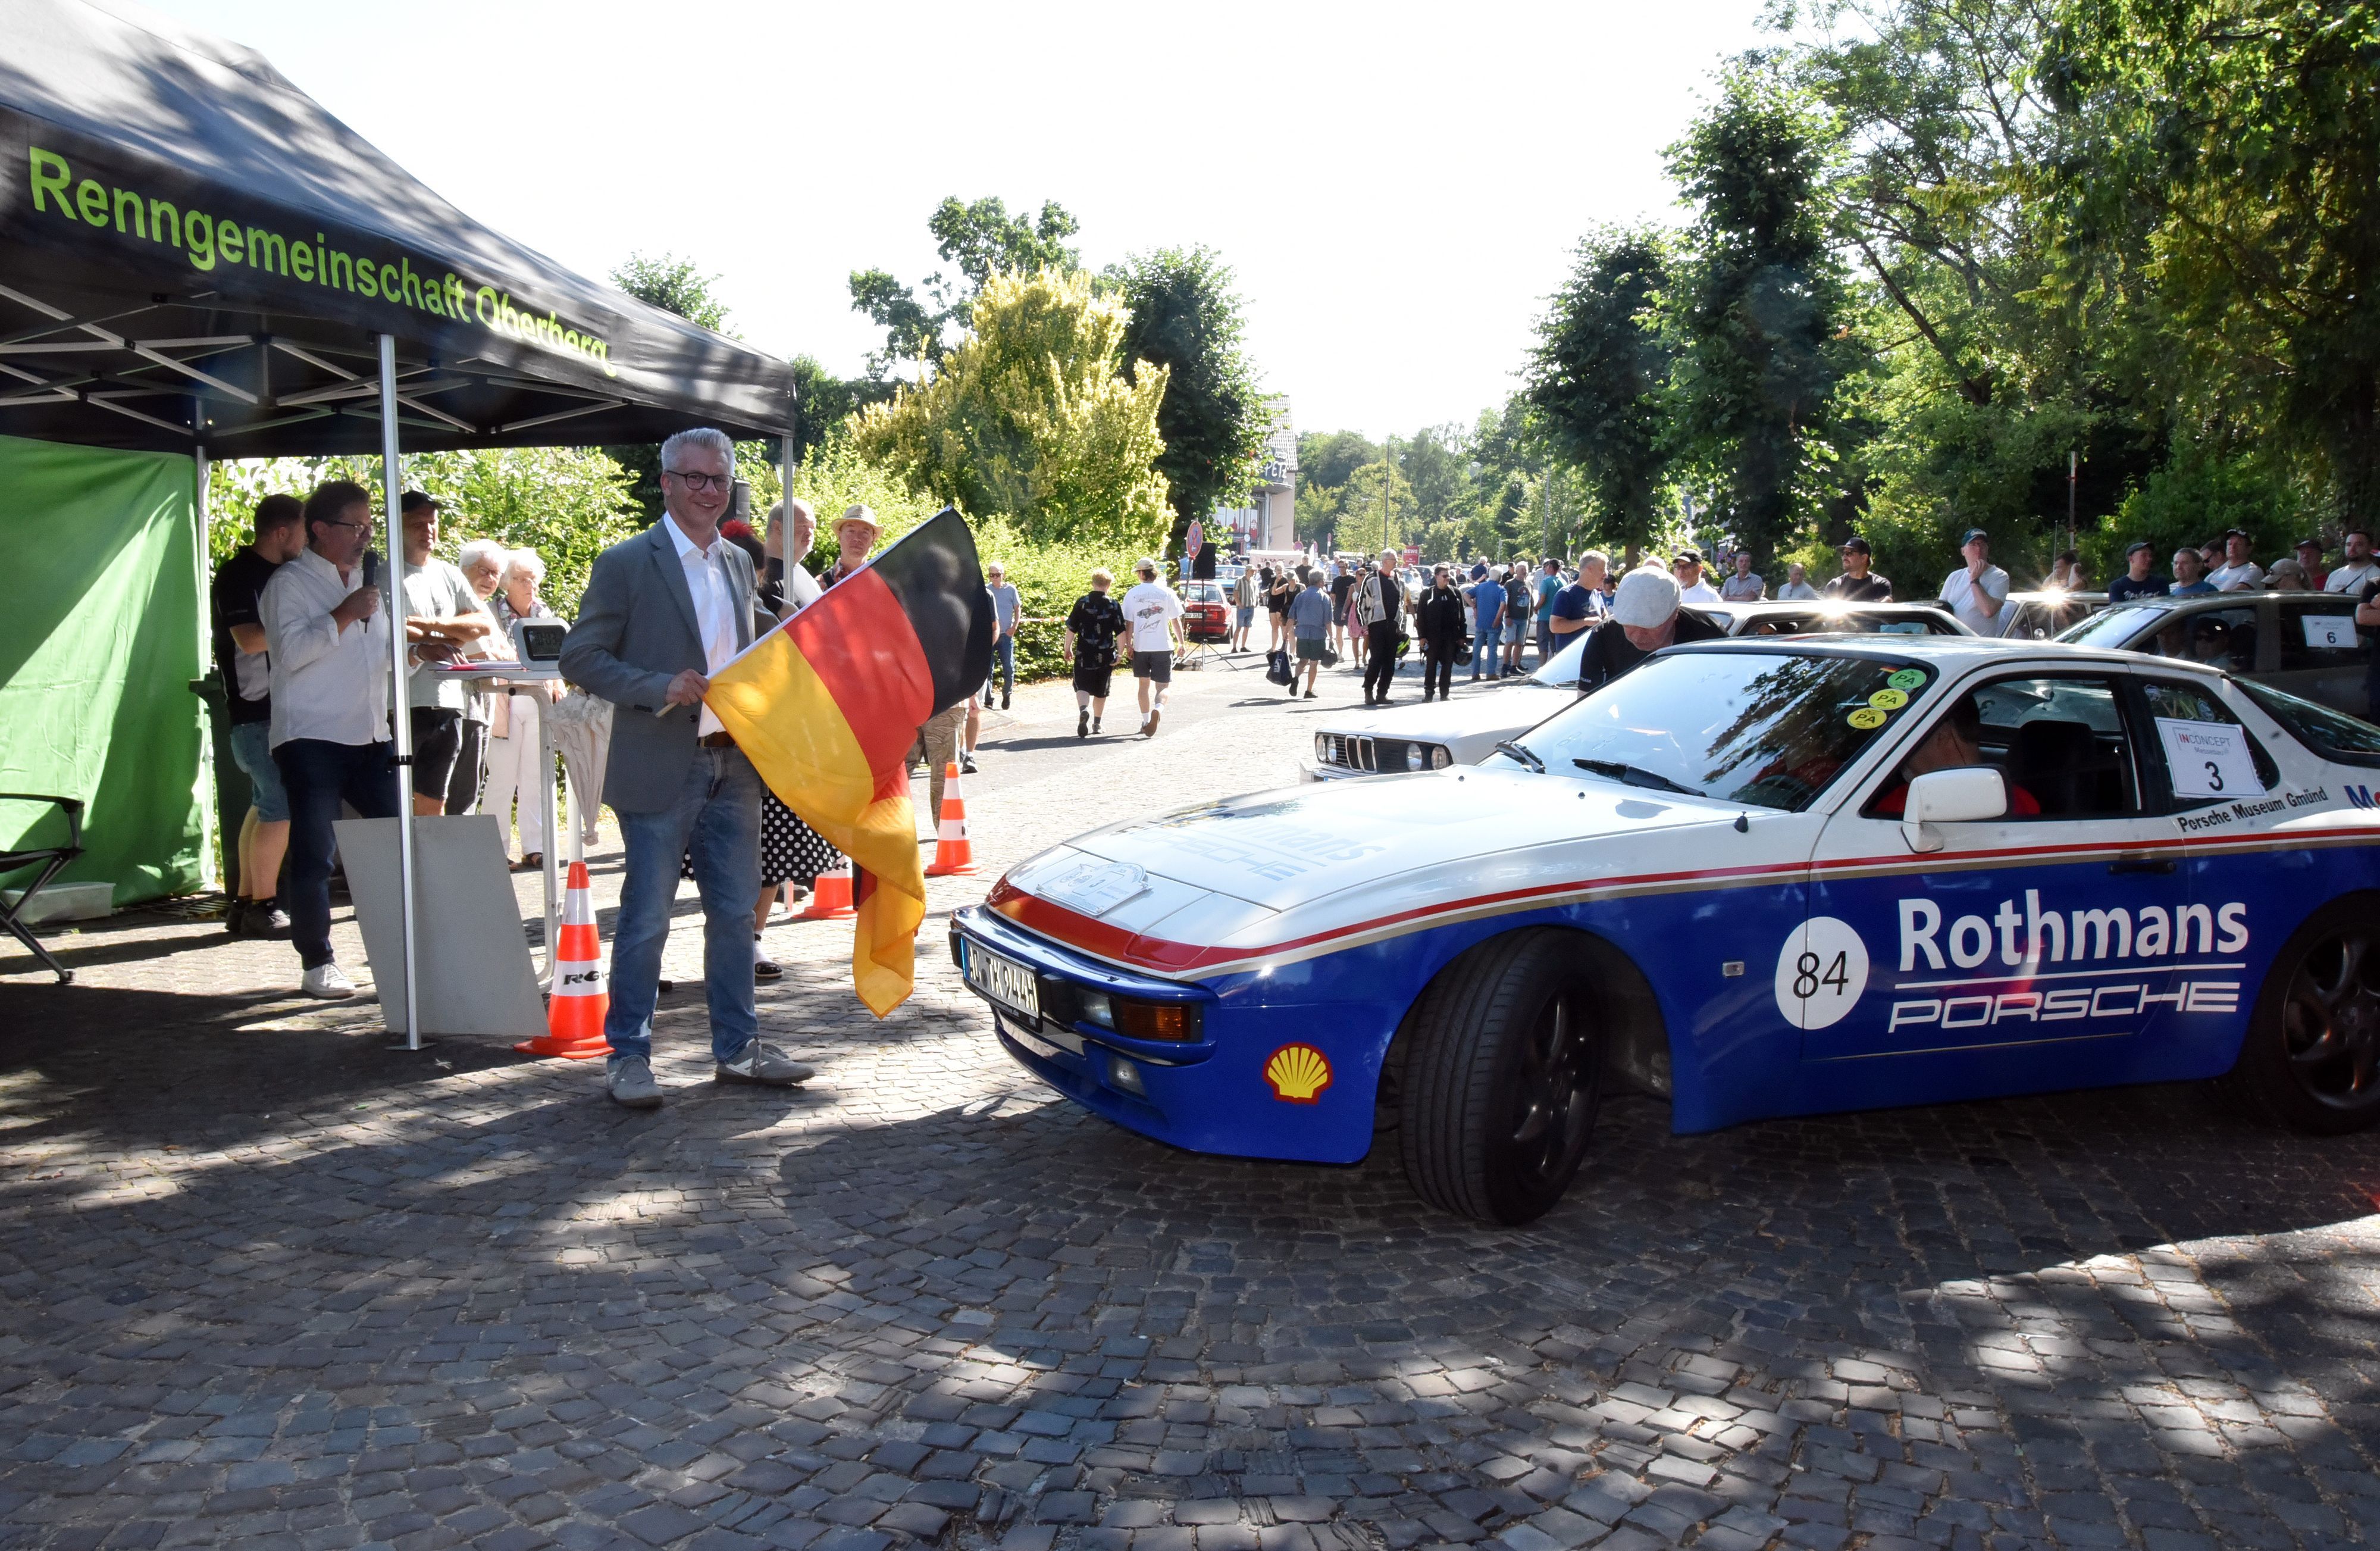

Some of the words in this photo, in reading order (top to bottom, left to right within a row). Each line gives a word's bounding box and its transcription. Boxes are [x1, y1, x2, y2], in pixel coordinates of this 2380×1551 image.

[29, 146, 472, 324] Renngemeinschaft
[476, 286, 617, 377] Oberberg
[2326, 631, 2337, 644] 6
[1895, 674, 1915, 685] PA
[1877, 694, 1897, 705] PA
[1855, 714, 1875, 724] PA
[2178, 733, 2231, 747] INCONCEPT
[2204, 761, 2224, 792] 3
[2178, 809, 2232, 833] Porsche
[2231, 797, 2286, 820] Museum
[2285, 786, 2329, 808] Gmünd
[1898, 889, 2249, 972] Rothmans
[1792, 950, 1849, 999] 84
[1887, 981, 2241, 1033] PORSCHE
